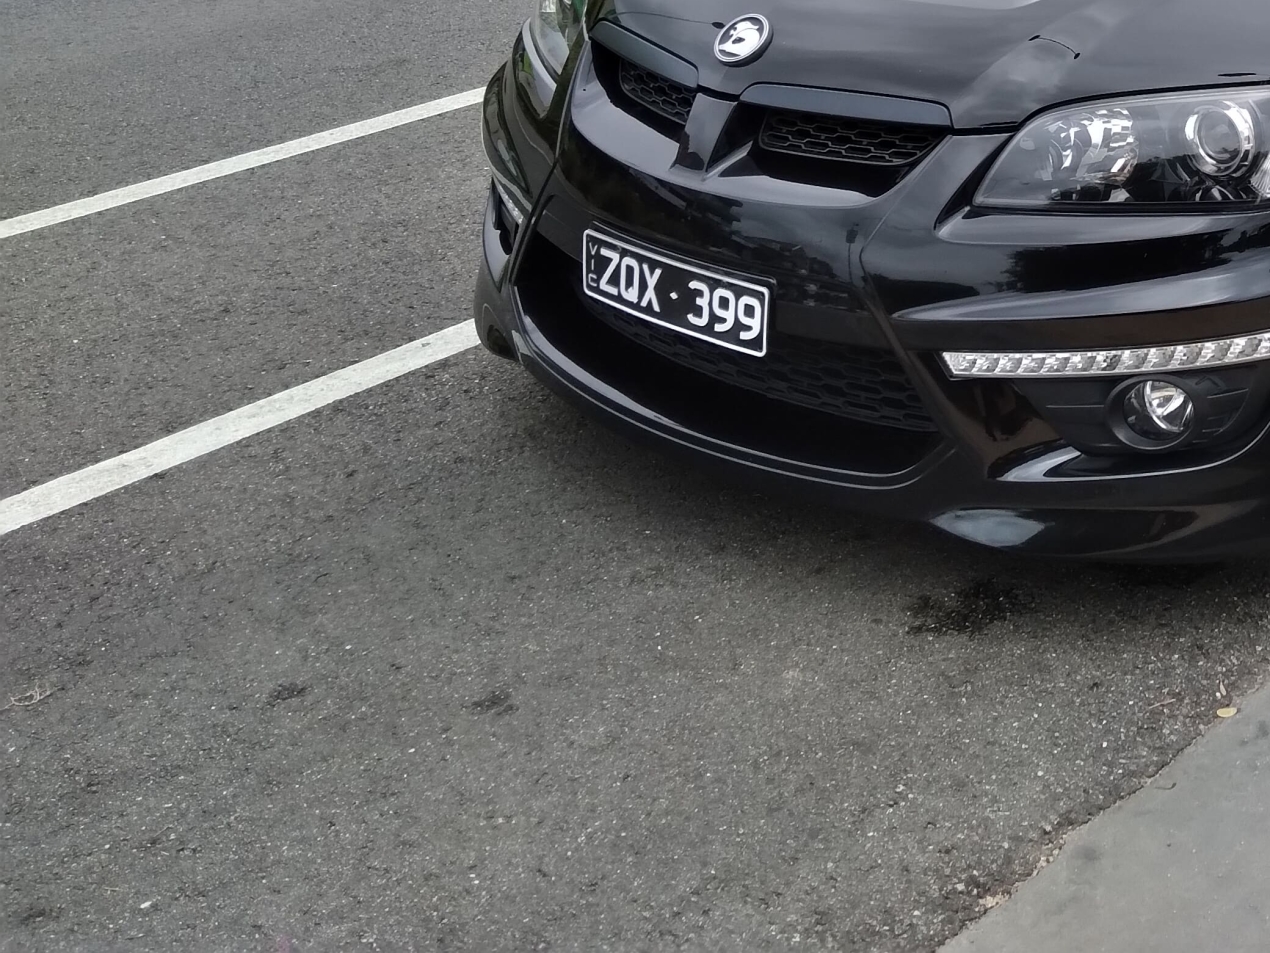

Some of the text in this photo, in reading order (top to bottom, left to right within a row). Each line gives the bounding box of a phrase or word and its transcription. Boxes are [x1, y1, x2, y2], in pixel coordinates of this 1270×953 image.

[588, 242, 598, 287] VIC
[599, 247, 762, 341] ZQX 399
